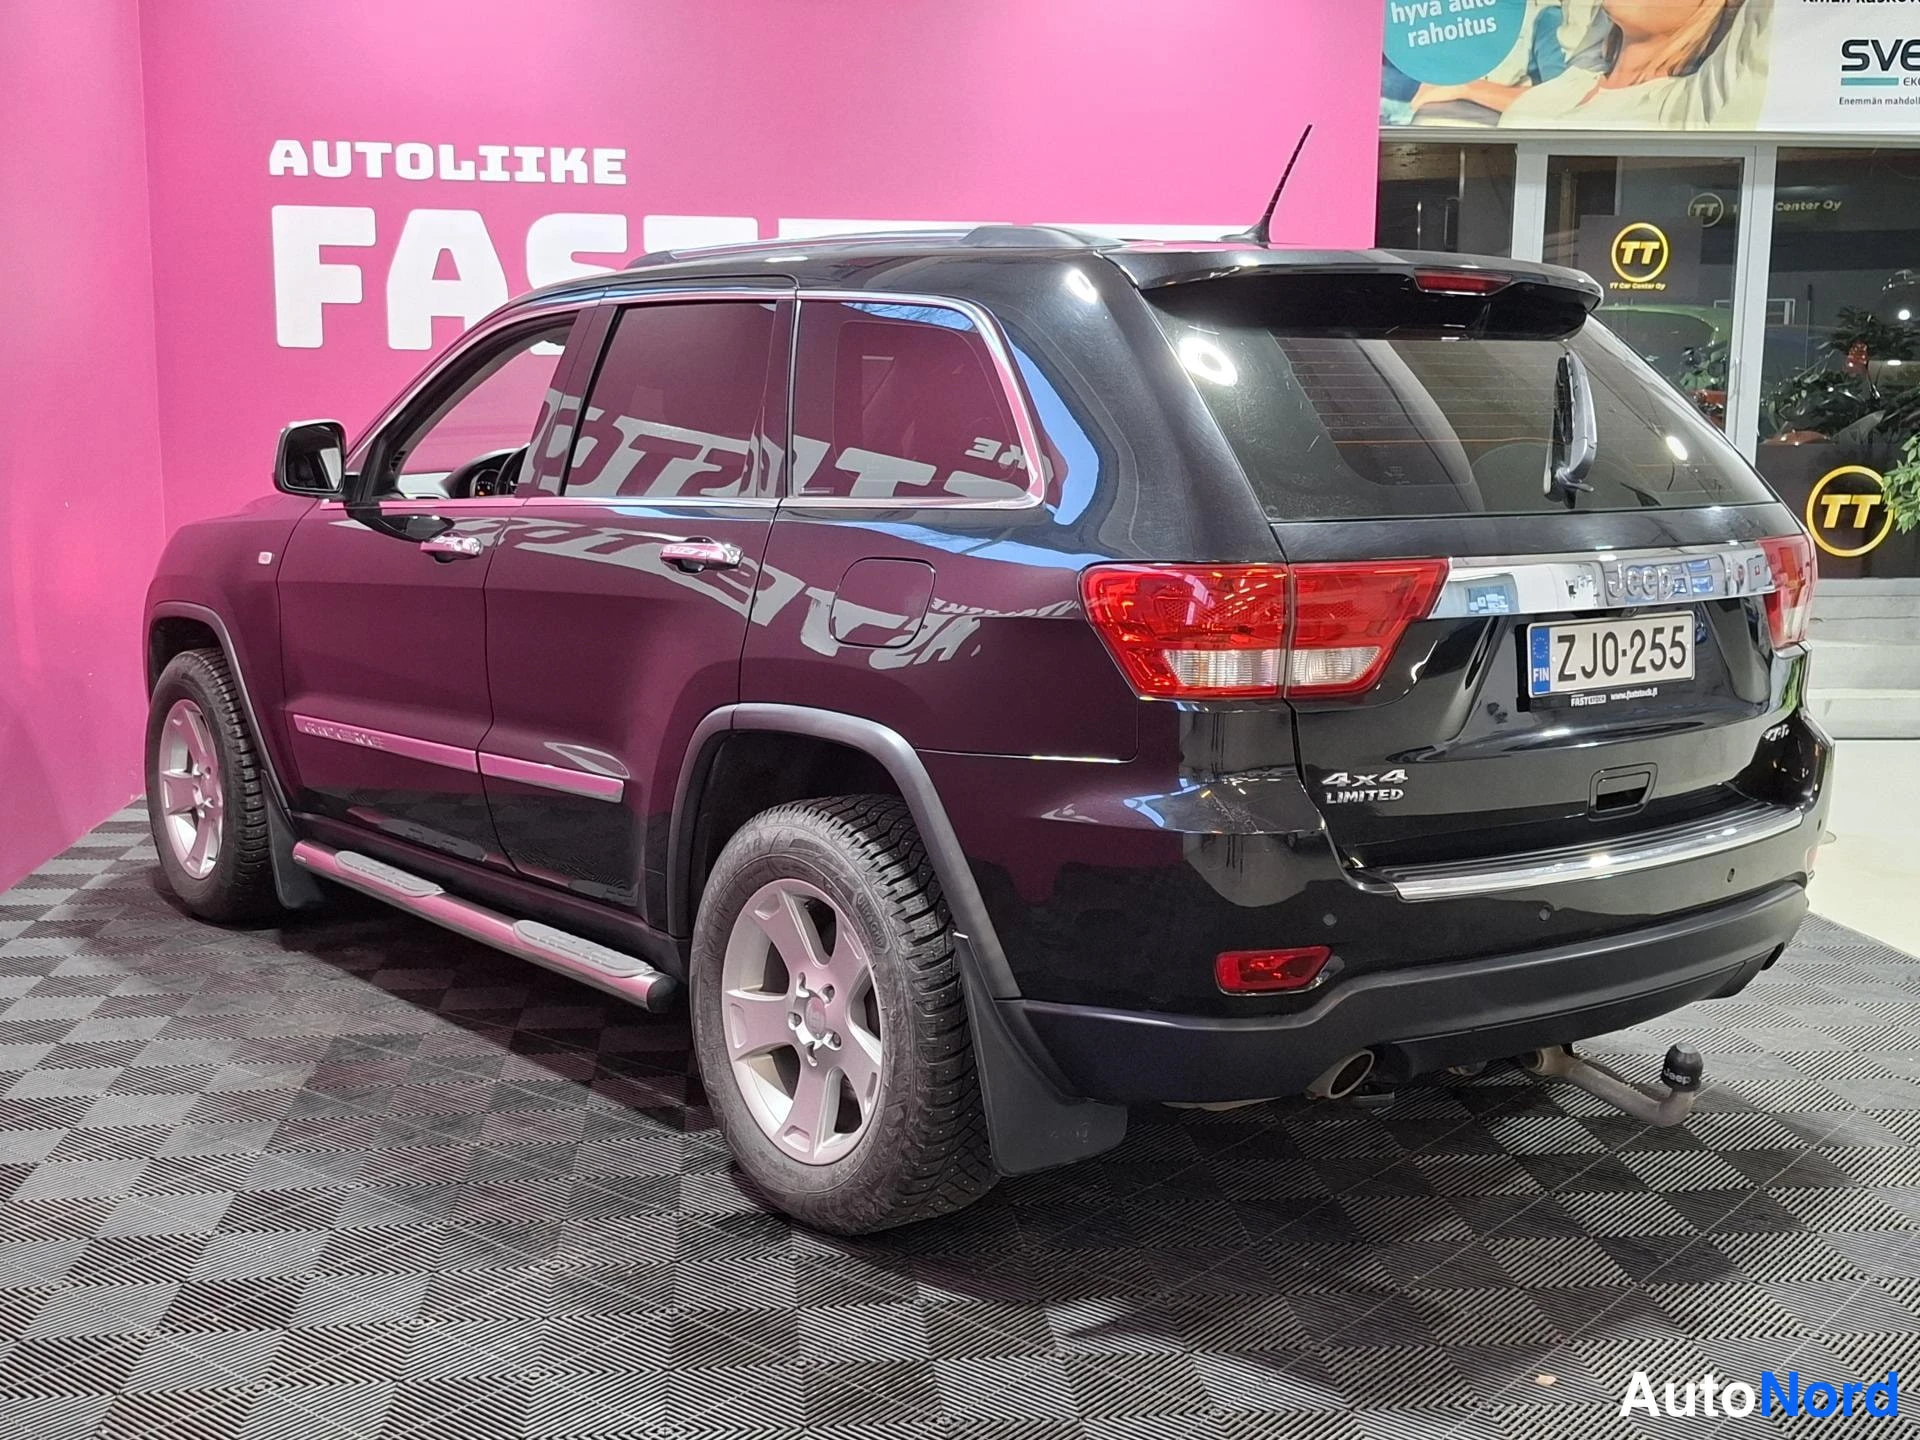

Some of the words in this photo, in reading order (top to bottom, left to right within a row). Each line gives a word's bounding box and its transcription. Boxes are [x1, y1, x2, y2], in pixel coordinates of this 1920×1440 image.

[1408, 16, 1497, 47] rahoitus
[1839, 96, 1883, 105] Enemmän
[268, 139, 627, 185] AUTOLIIKE
[1775, 201, 1820, 212] Center
[1823, 200, 1843, 211] Oy
[1620, 241, 1660, 265] TT
[1820, 494, 1882, 529] TT
[1533, 667, 1550, 682] FIN
[1326, 788, 1405, 804] LIMITED
